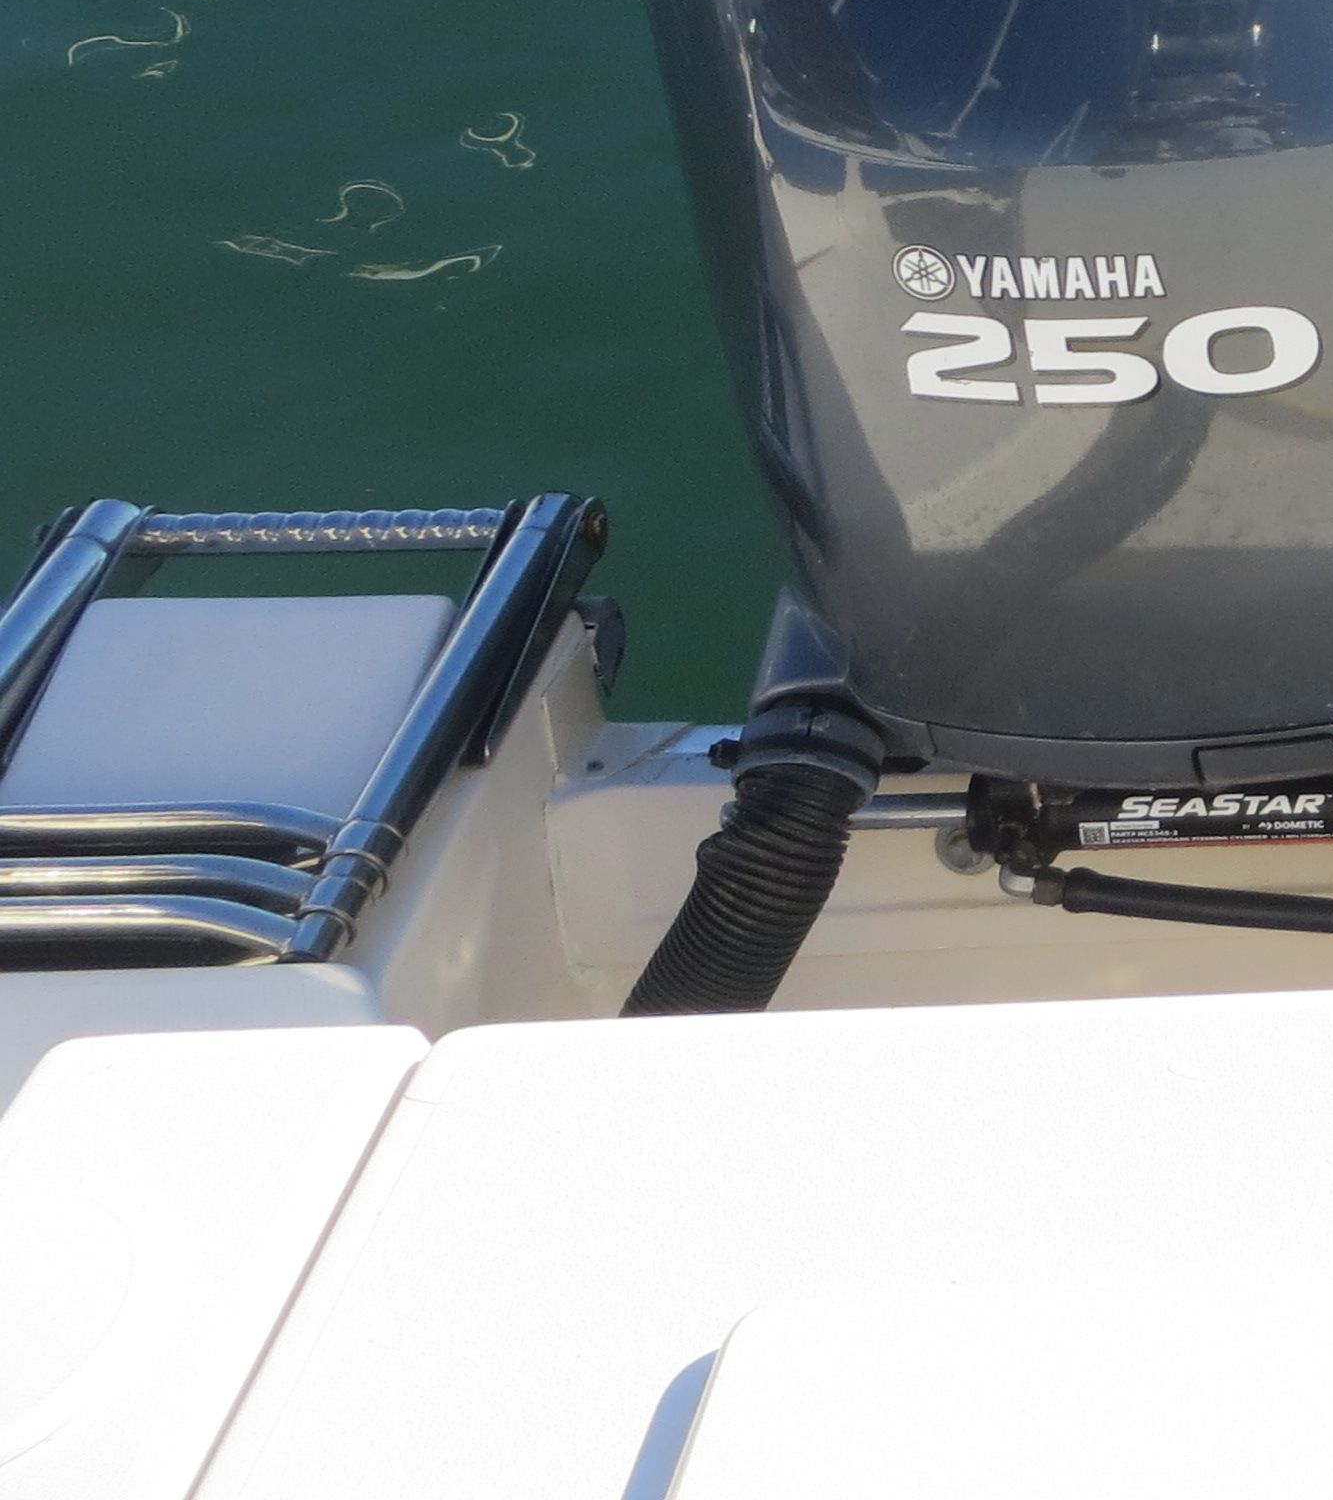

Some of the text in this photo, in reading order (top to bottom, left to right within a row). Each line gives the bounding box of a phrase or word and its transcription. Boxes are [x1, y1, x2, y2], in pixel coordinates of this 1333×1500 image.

[954, 252, 1168, 299] YAMAHA
[900, 305, 1322, 405] 250
[1117, 793, 1327, 819] SEASTAR
[1273, 819, 1325, 830] DOMETIC
